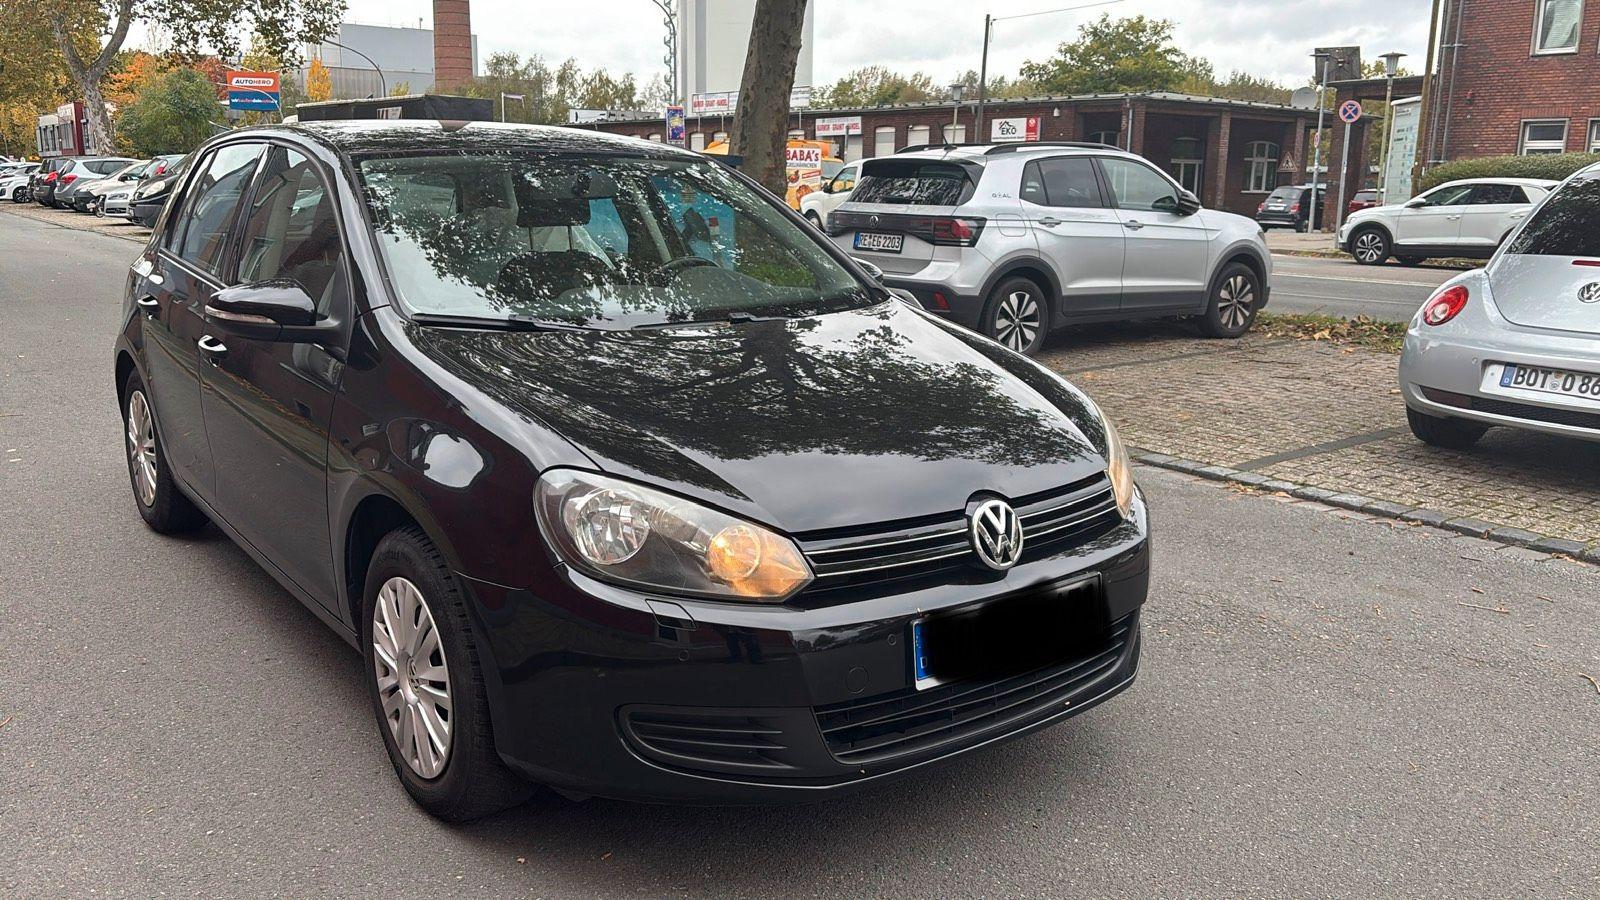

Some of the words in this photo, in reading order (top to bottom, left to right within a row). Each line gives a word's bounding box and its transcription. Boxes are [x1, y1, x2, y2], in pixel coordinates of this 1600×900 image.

[1001, 127, 1017, 135] EKO
[860, 234, 868, 246] RE
[872, 235, 882, 247] EG
[882, 236, 900, 248] 2203
[1513, 366, 1552, 388] BOT
